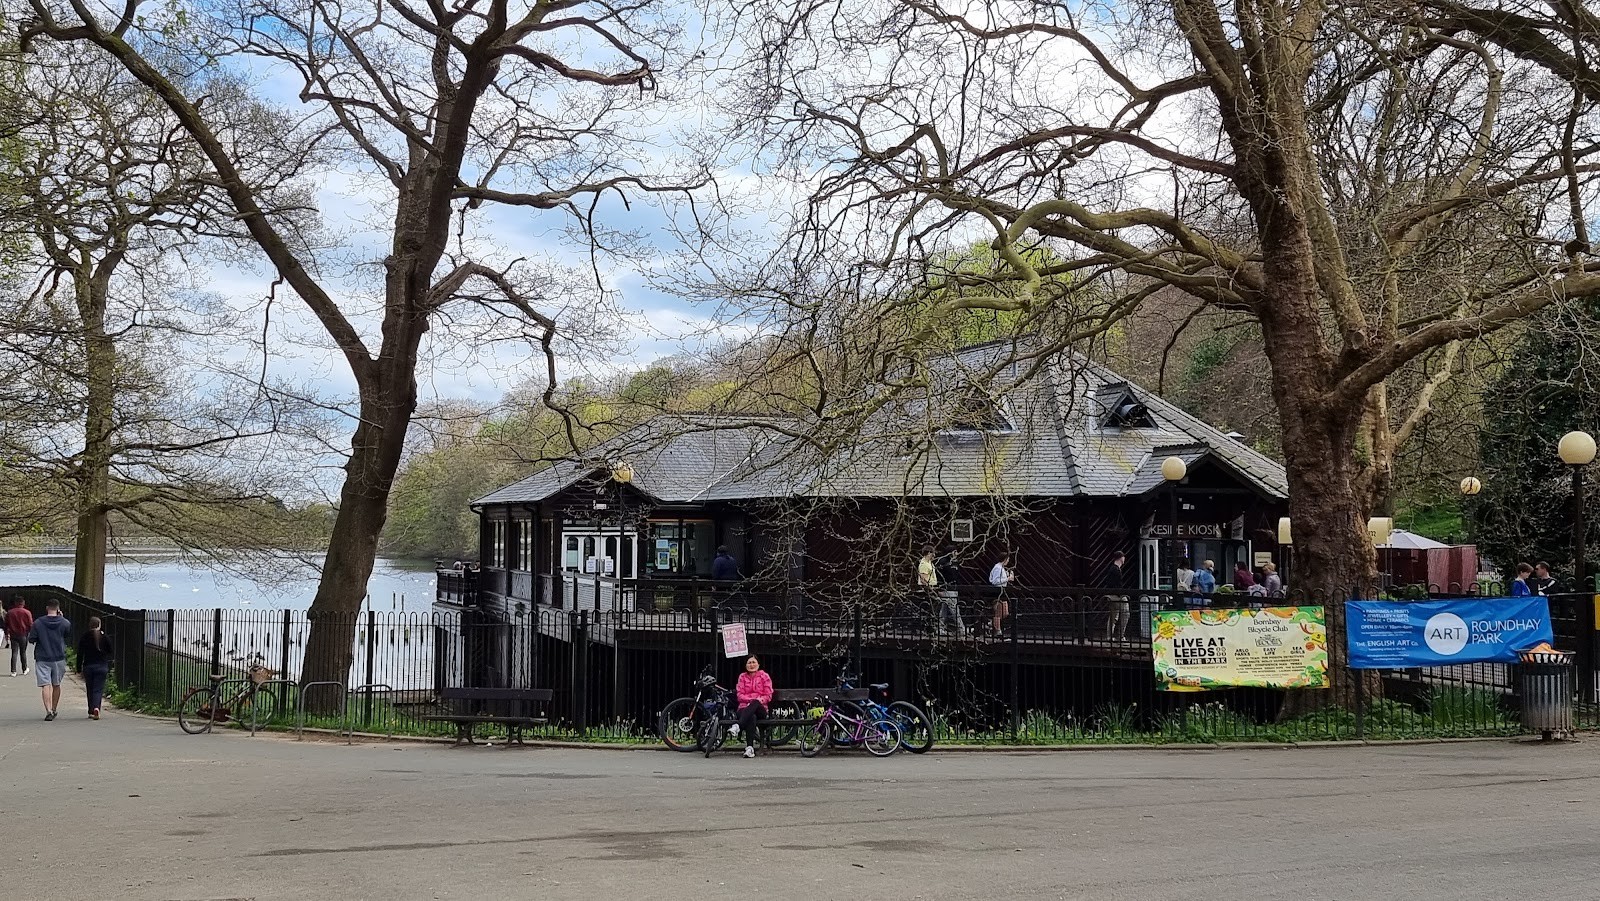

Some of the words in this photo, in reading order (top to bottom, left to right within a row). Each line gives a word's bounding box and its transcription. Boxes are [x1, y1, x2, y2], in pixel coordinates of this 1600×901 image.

[1140, 524, 1184, 535] KESIE
[1188, 524, 1219, 535] KIOSK
[1248, 626, 1272, 634] Bicycle
[1471, 618, 1542, 632] ROUNDHAY
[1430, 627, 1463, 640] ART
[1472, 633, 1504, 644] PARK
[1174, 638, 1204, 648] LIVE
[1208, 637, 1225, 647] AT
[1174, 648, 1215, 658] LEEDS
